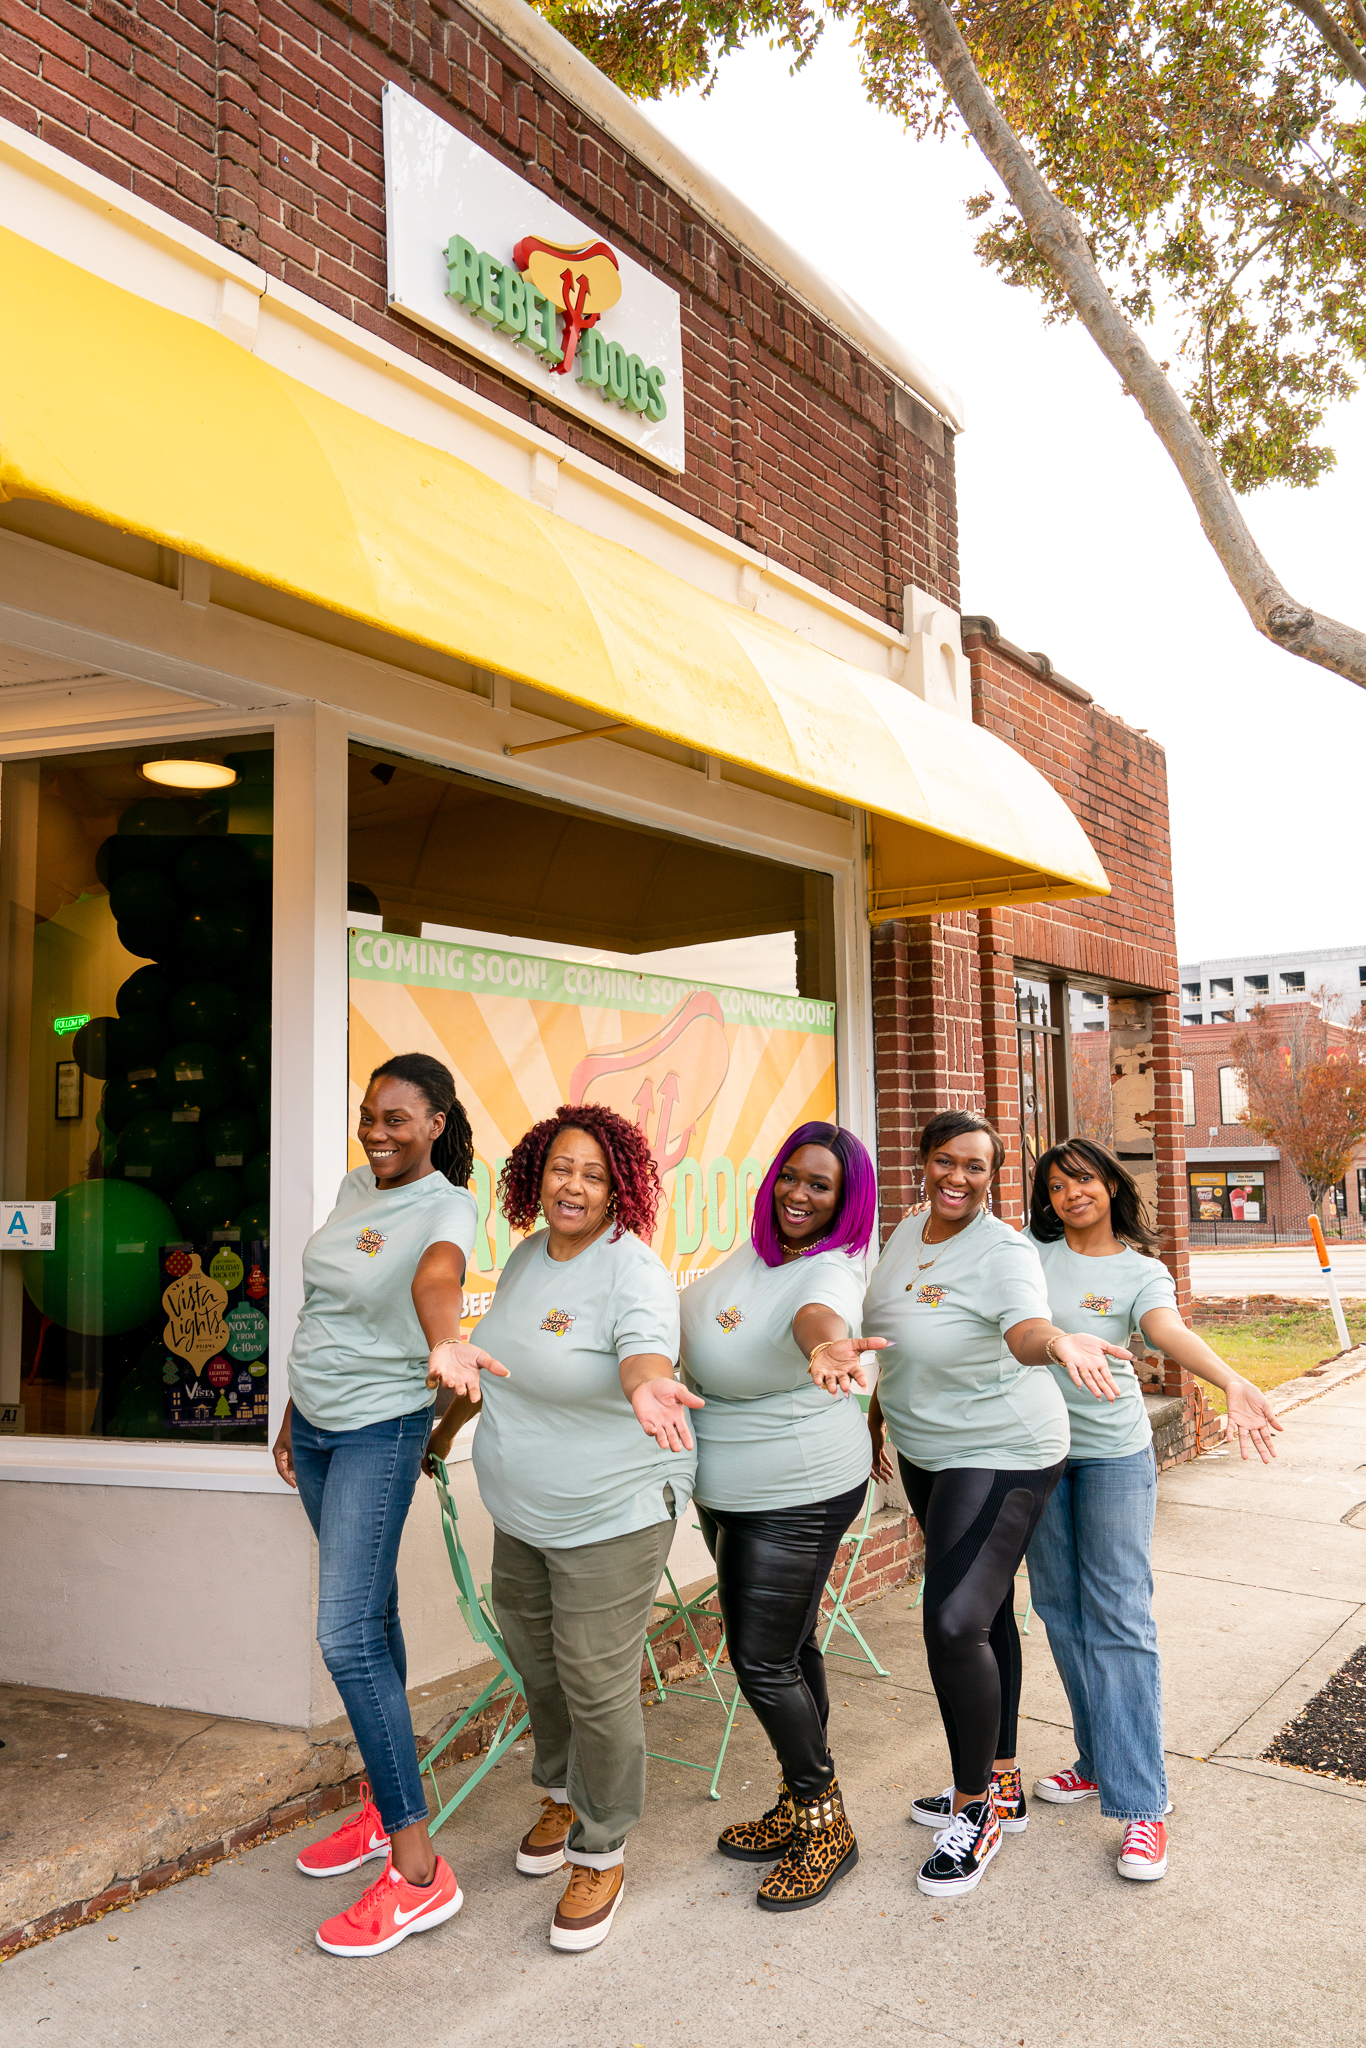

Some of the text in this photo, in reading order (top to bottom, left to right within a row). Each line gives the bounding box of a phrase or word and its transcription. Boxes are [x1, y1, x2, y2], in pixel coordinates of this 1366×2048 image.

[447, 234, 667, 423] REBEL DOGS
[355, 935, 548, 990] COMING SOON!
[563, 966, 645, 1003] COMING
[719, 989, 831, 1027] COMING SOON!
[7, 1211, 28, 1234] A
[672, 1156, 777, 1255] DOG
[670, 1267, 714, 1291] LUT
[167, 1280, 219, 1317] Vista
[170, 1301, 226, 1353] Lights
[228, 1319, 264, 1331] NOV. 16
[540, 1321, 561, 1332] DOGS
[547, 1312, 568, 1323] REBEL
[185, 1381, 215, 1400] VISTA
